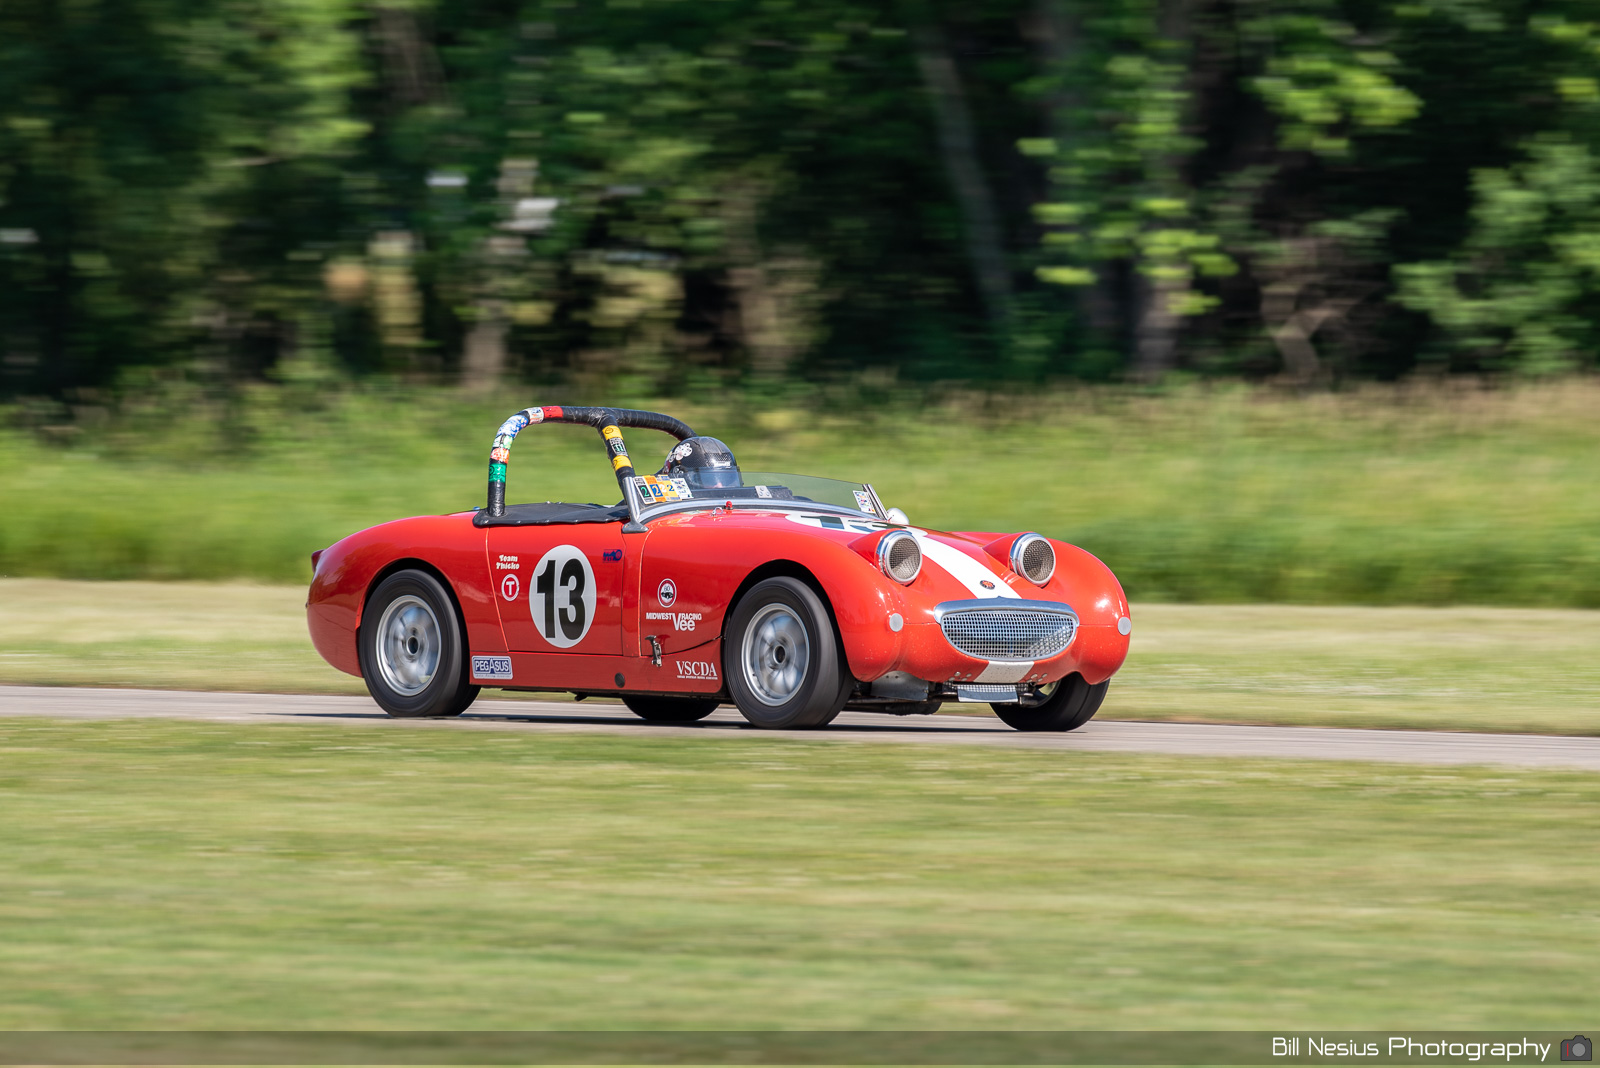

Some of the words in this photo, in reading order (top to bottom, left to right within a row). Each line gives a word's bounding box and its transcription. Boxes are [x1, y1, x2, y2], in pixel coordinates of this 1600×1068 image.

[641, 487, 650, 497] 2
[652, 485, 662, 496] 2
[667, 484, 675, 492] 2
[506, 581, 515, 596] T
[537, 558, 586, 640] 13
[646, 612, 673, 620] MIDWEST
[681, 612, 702, 621] RACING
[672, 612, 695, 631] Vee
[475, 659, 509, 672] PEGASUS
[676, 660, 718, 677] VSCDA
